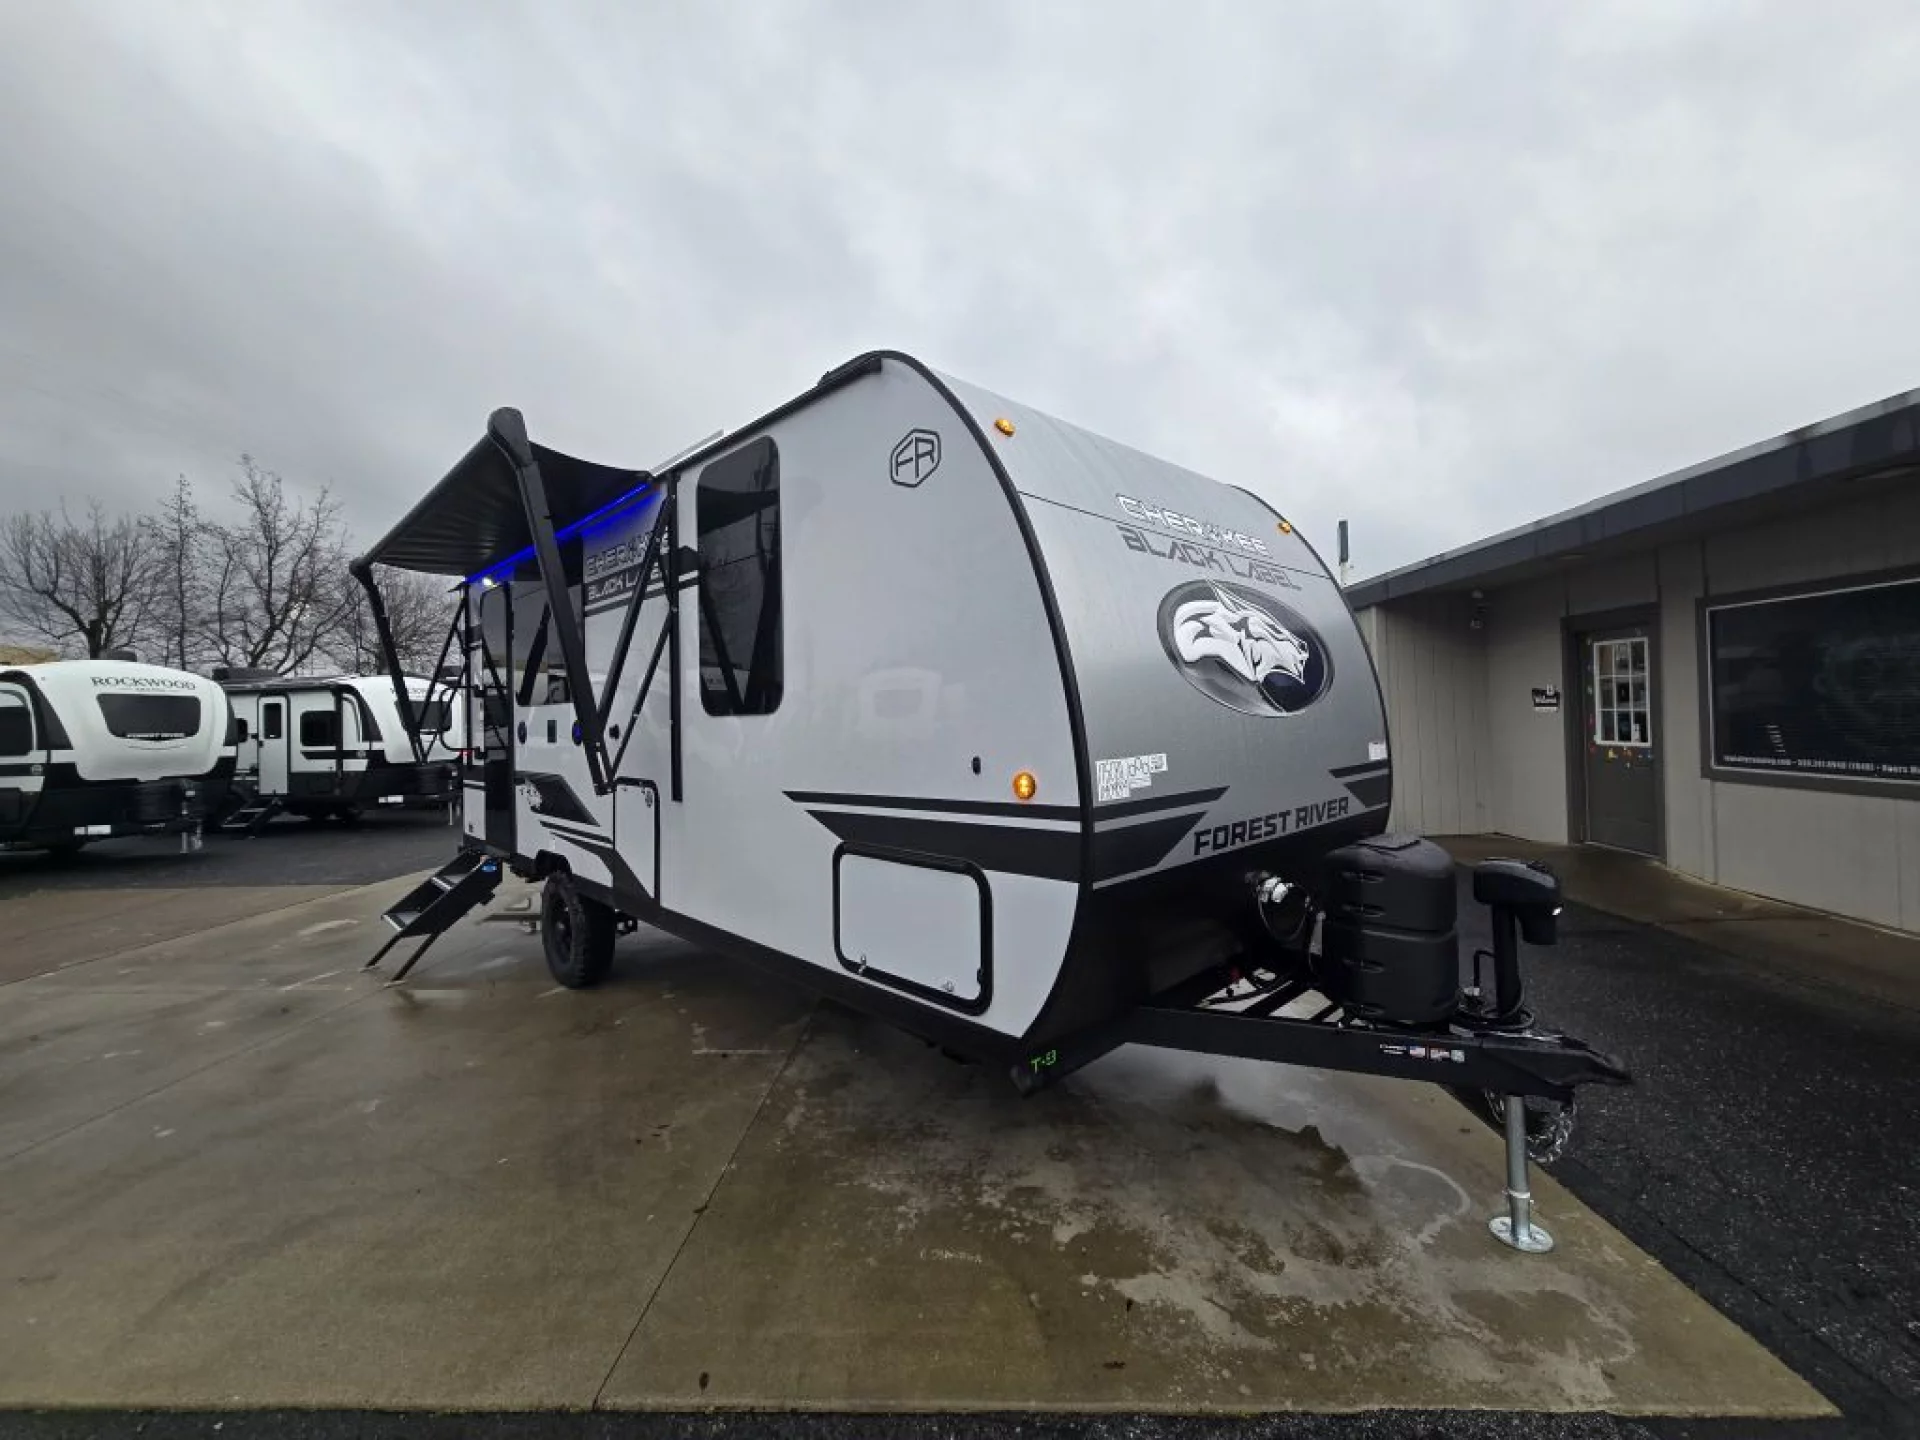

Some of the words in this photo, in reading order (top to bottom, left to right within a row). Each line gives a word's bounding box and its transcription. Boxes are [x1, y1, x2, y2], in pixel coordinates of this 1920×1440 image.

[1117, 525, 1225, 573] BLACK
[1224, 554, 1302, 590] LABEL
[588, 570, 624, 600] BLACK
[90, 677, 196, 690] ROCKWOOD
[1194, 810, 1292, 856] FOREST
[1294, 796, 1349, 829] RIVER
